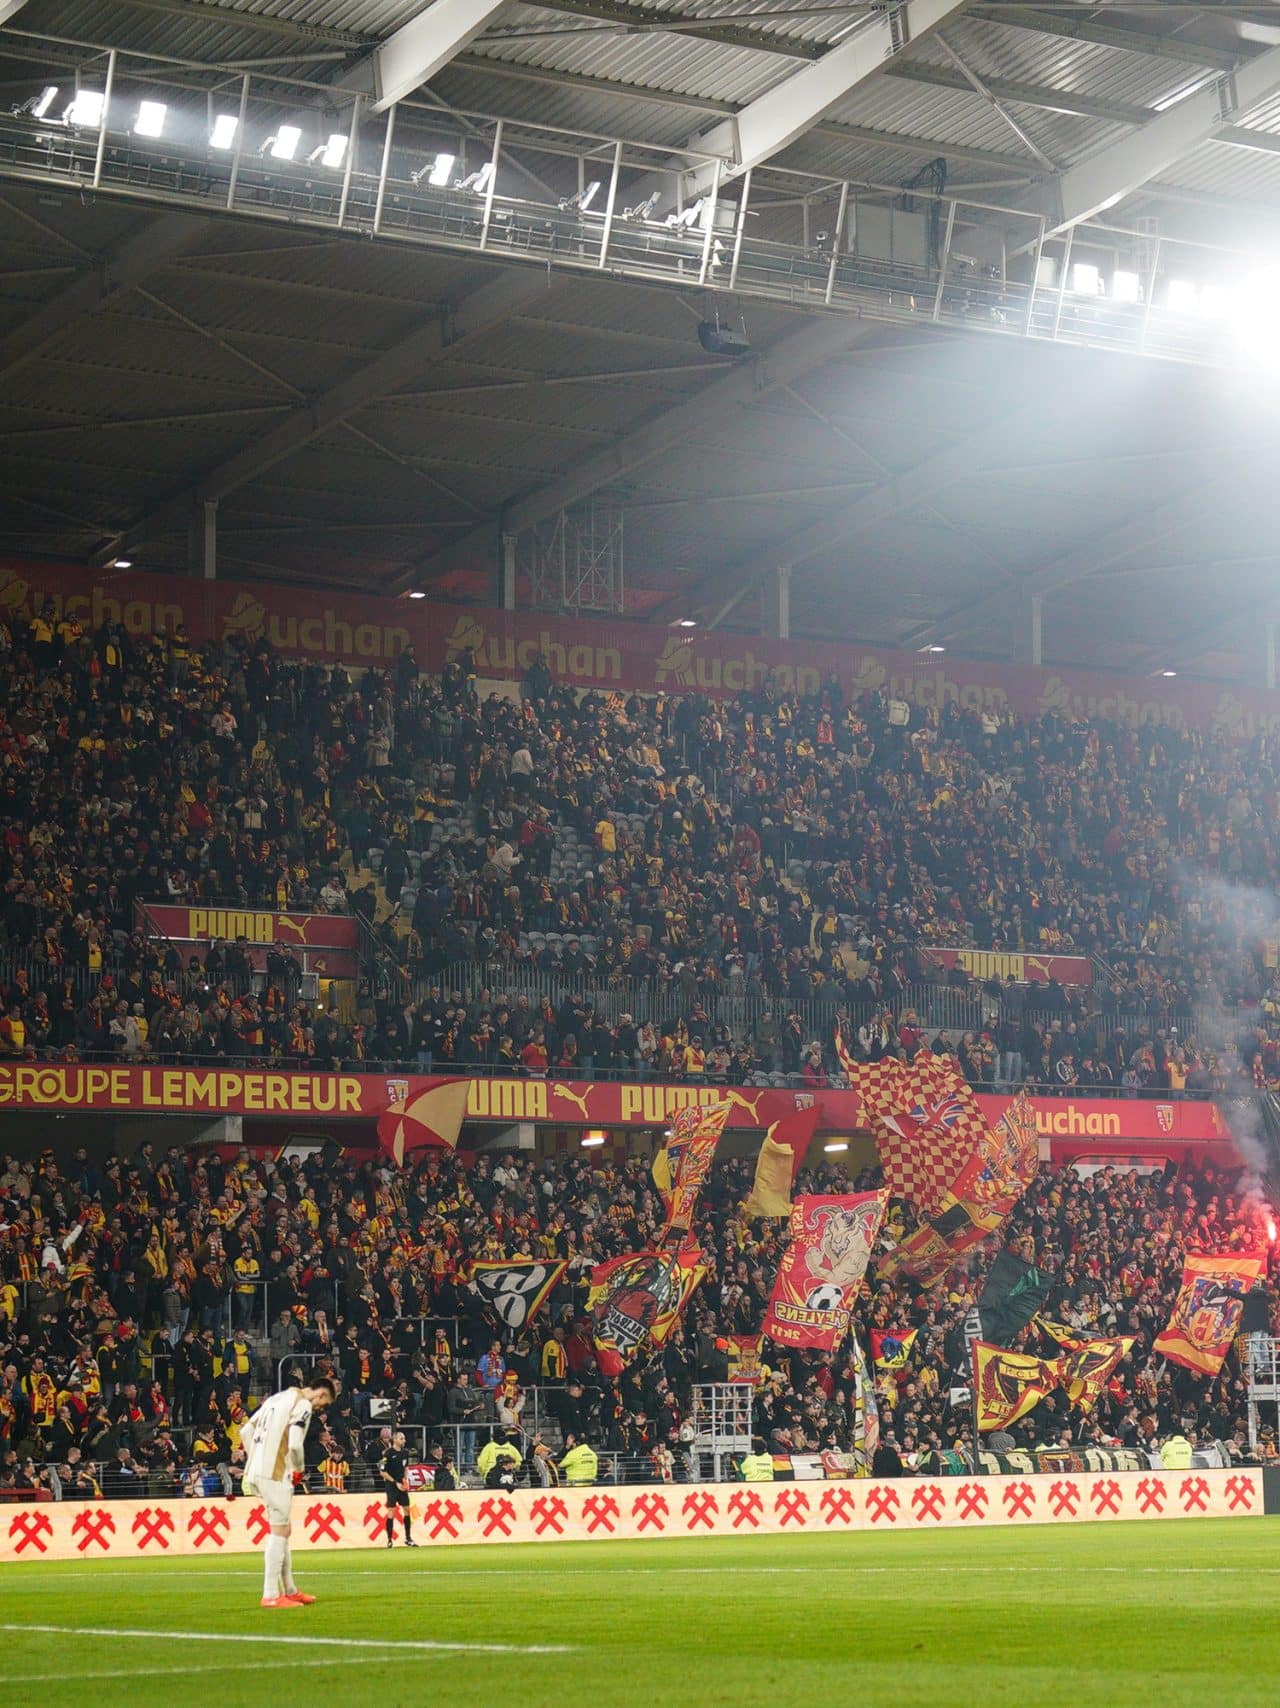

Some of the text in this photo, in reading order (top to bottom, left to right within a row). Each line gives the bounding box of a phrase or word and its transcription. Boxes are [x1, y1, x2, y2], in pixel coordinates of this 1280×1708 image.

[222, 592, 411, 658] Auchan
[447, 616, 621, 679] Auchan
[655, 636, 819, 698] Auchan
[852, 656, 1007, 711] Auchan
[189, 909, 273, 942] PUMA
[958, 951, 1025, 980] PUMA
[142, 1070, 363, 1112] LEMPEREUR
[467, 1079, 549, 1119] UMA
[1036, 1105, 1121, 1135] uchan
